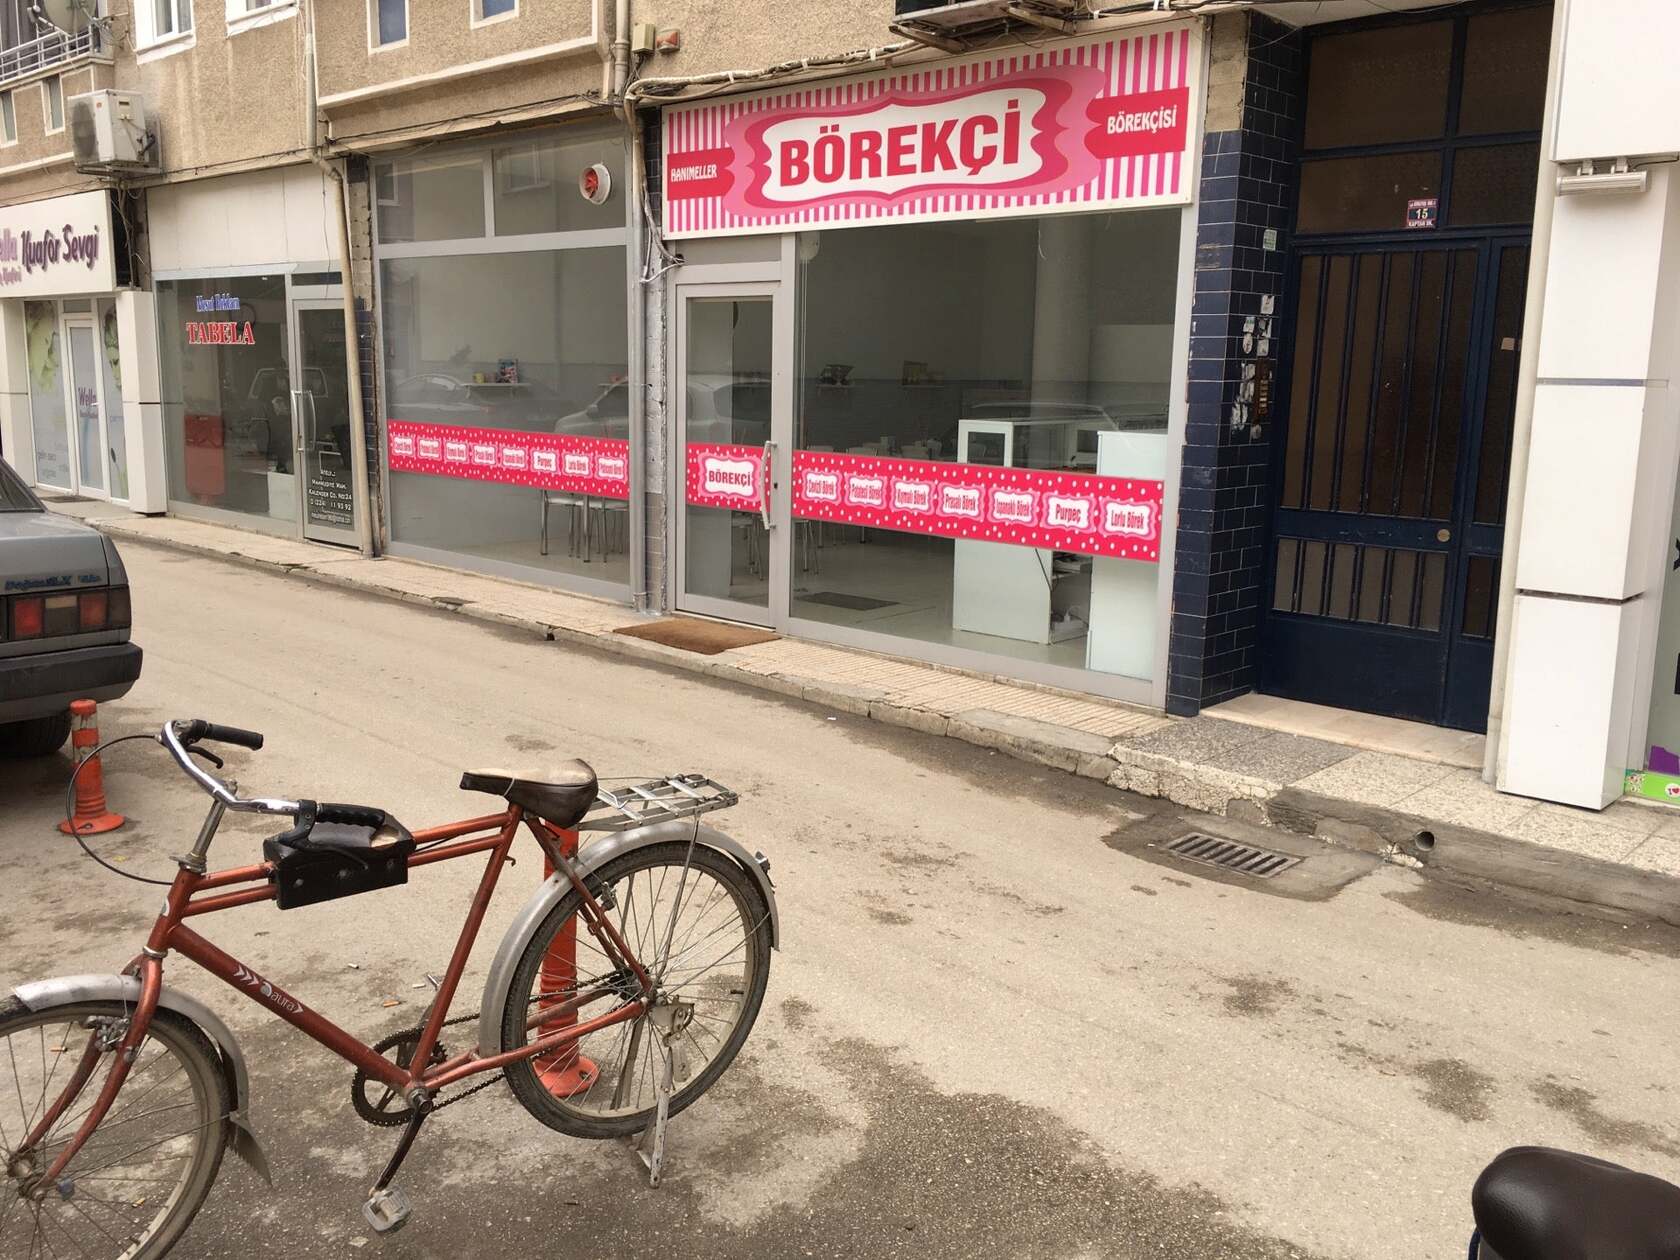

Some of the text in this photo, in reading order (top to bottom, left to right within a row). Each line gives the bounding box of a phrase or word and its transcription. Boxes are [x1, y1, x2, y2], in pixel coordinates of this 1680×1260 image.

[1107, 104, 1177, 134] BÖREKÇİSİ
[780, 99, 1020, 187] BÖREKÇİ
[671, 164, 717, 182] HANIMELLER
[1416, 208, 1428, 219] 15
[62, 224, 99, 271] Sevgi
[186, 321, 255, 344] TABELA
[709, 469, 750, 487] BÖREKÇİ
[1127, 511, 1144, 529] Börek
[270, 991, 296, 1011] aura
